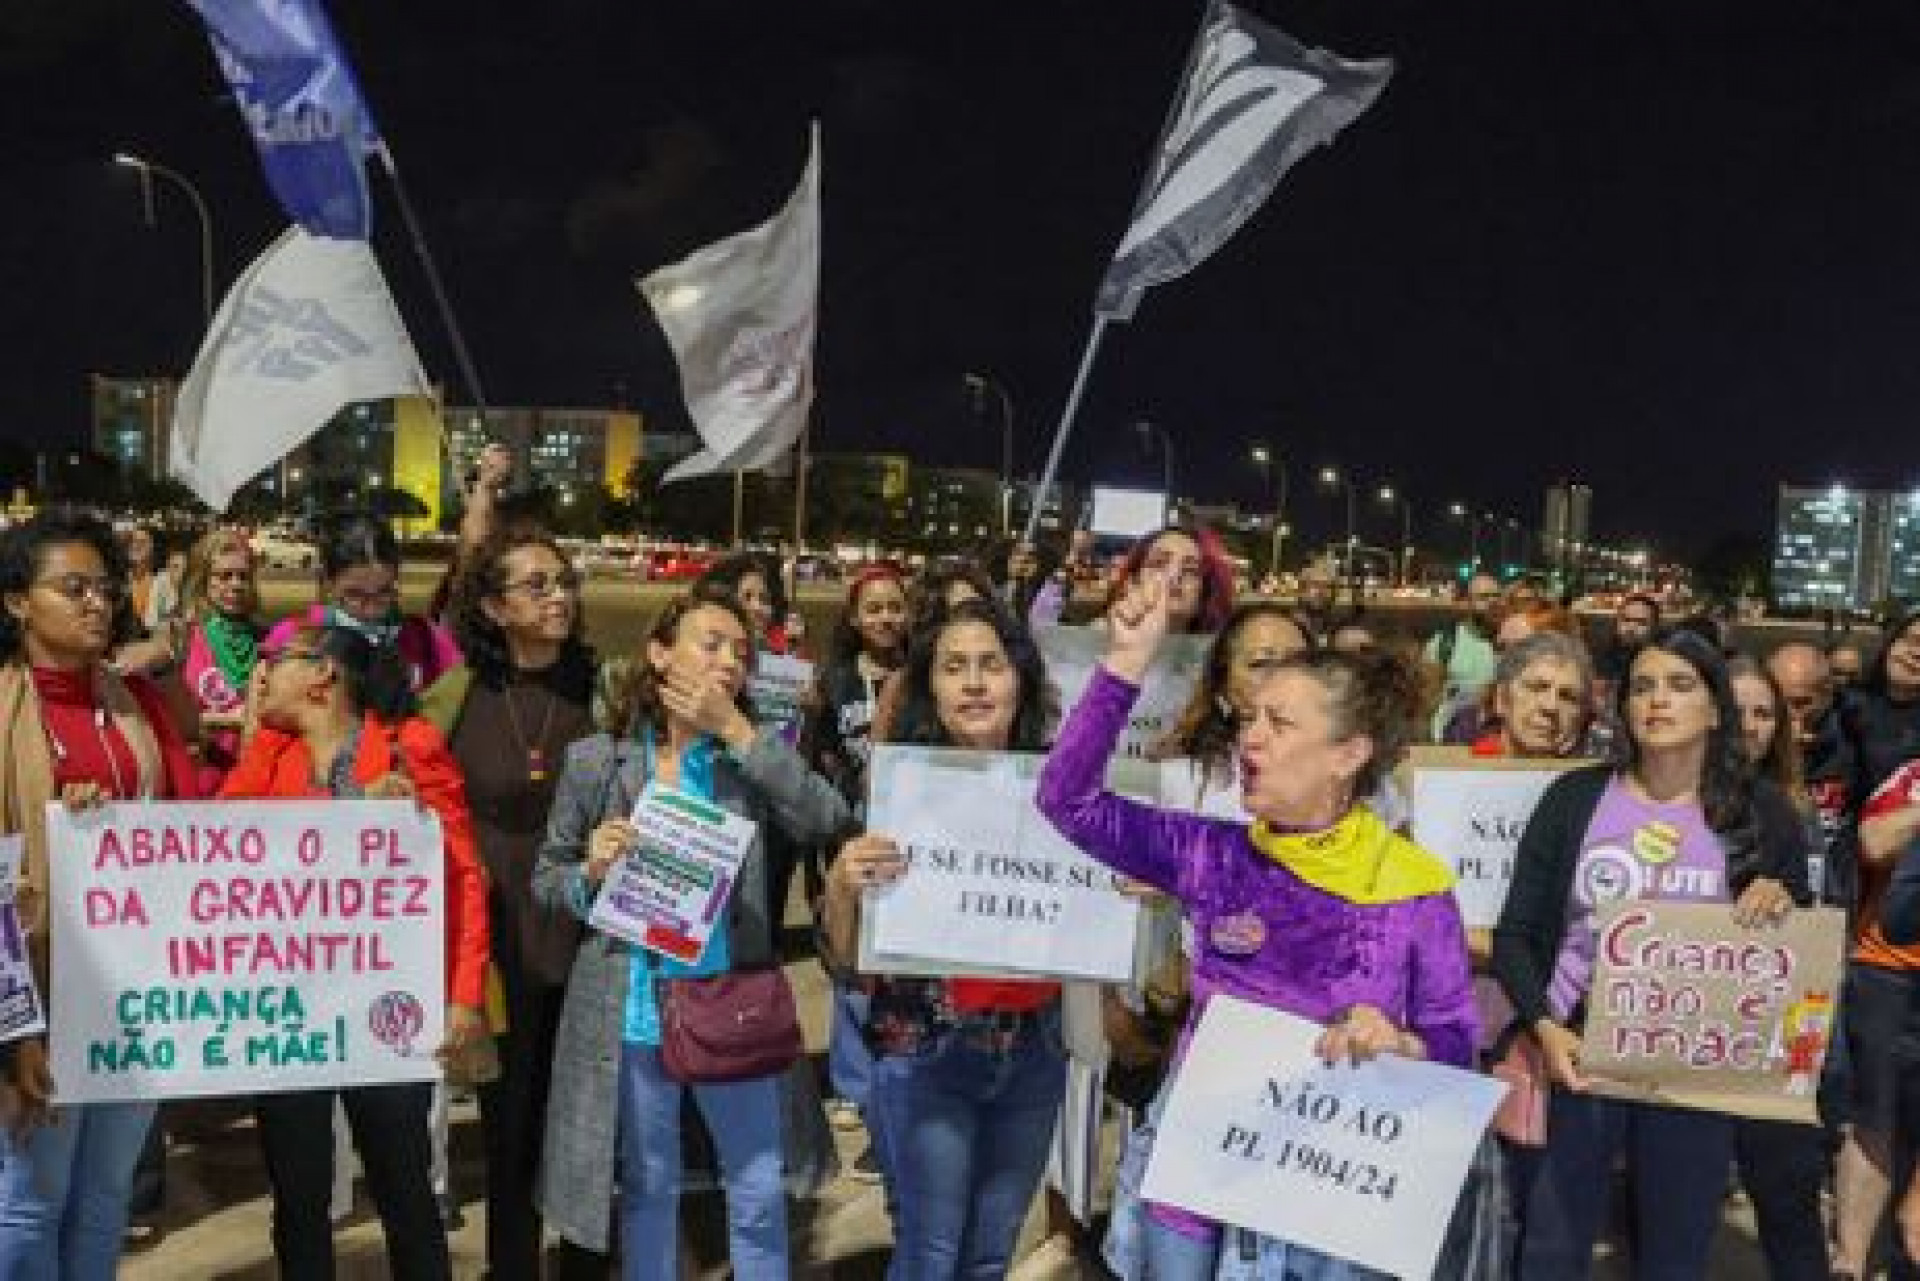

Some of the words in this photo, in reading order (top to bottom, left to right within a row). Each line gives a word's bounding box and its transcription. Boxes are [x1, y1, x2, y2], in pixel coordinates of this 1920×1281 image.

[94, 825, 267, 871] ABAIXO
[298, 828, 324, 865] O
[359, 828, 411, 867] PL
[973, 853, 1061, 886] FOSSE
[1457, 857, 1490, 880] PL
[85, 887, 149, 928] DA
[190, 874, 431, 924] GRAVIDEZ
[959, 890, 1062, 924] FILHA?
[167, 931, 394, 977] INFANTIL
[116, 985, 306, 1026] CRIANÇA
[88, 1026, 176, 1073] NÃO
[201, 1020, 229, 1069] É
[244, 1016, 347, 1066] MÃE!
[1259, 1077, 1341, 1123] NÃO
[1344, 1106, 1403, 1143] AO
[1220, 1124, 1265, 1161] PL
[1276, 1140, 1398, 1200] 1904/24
